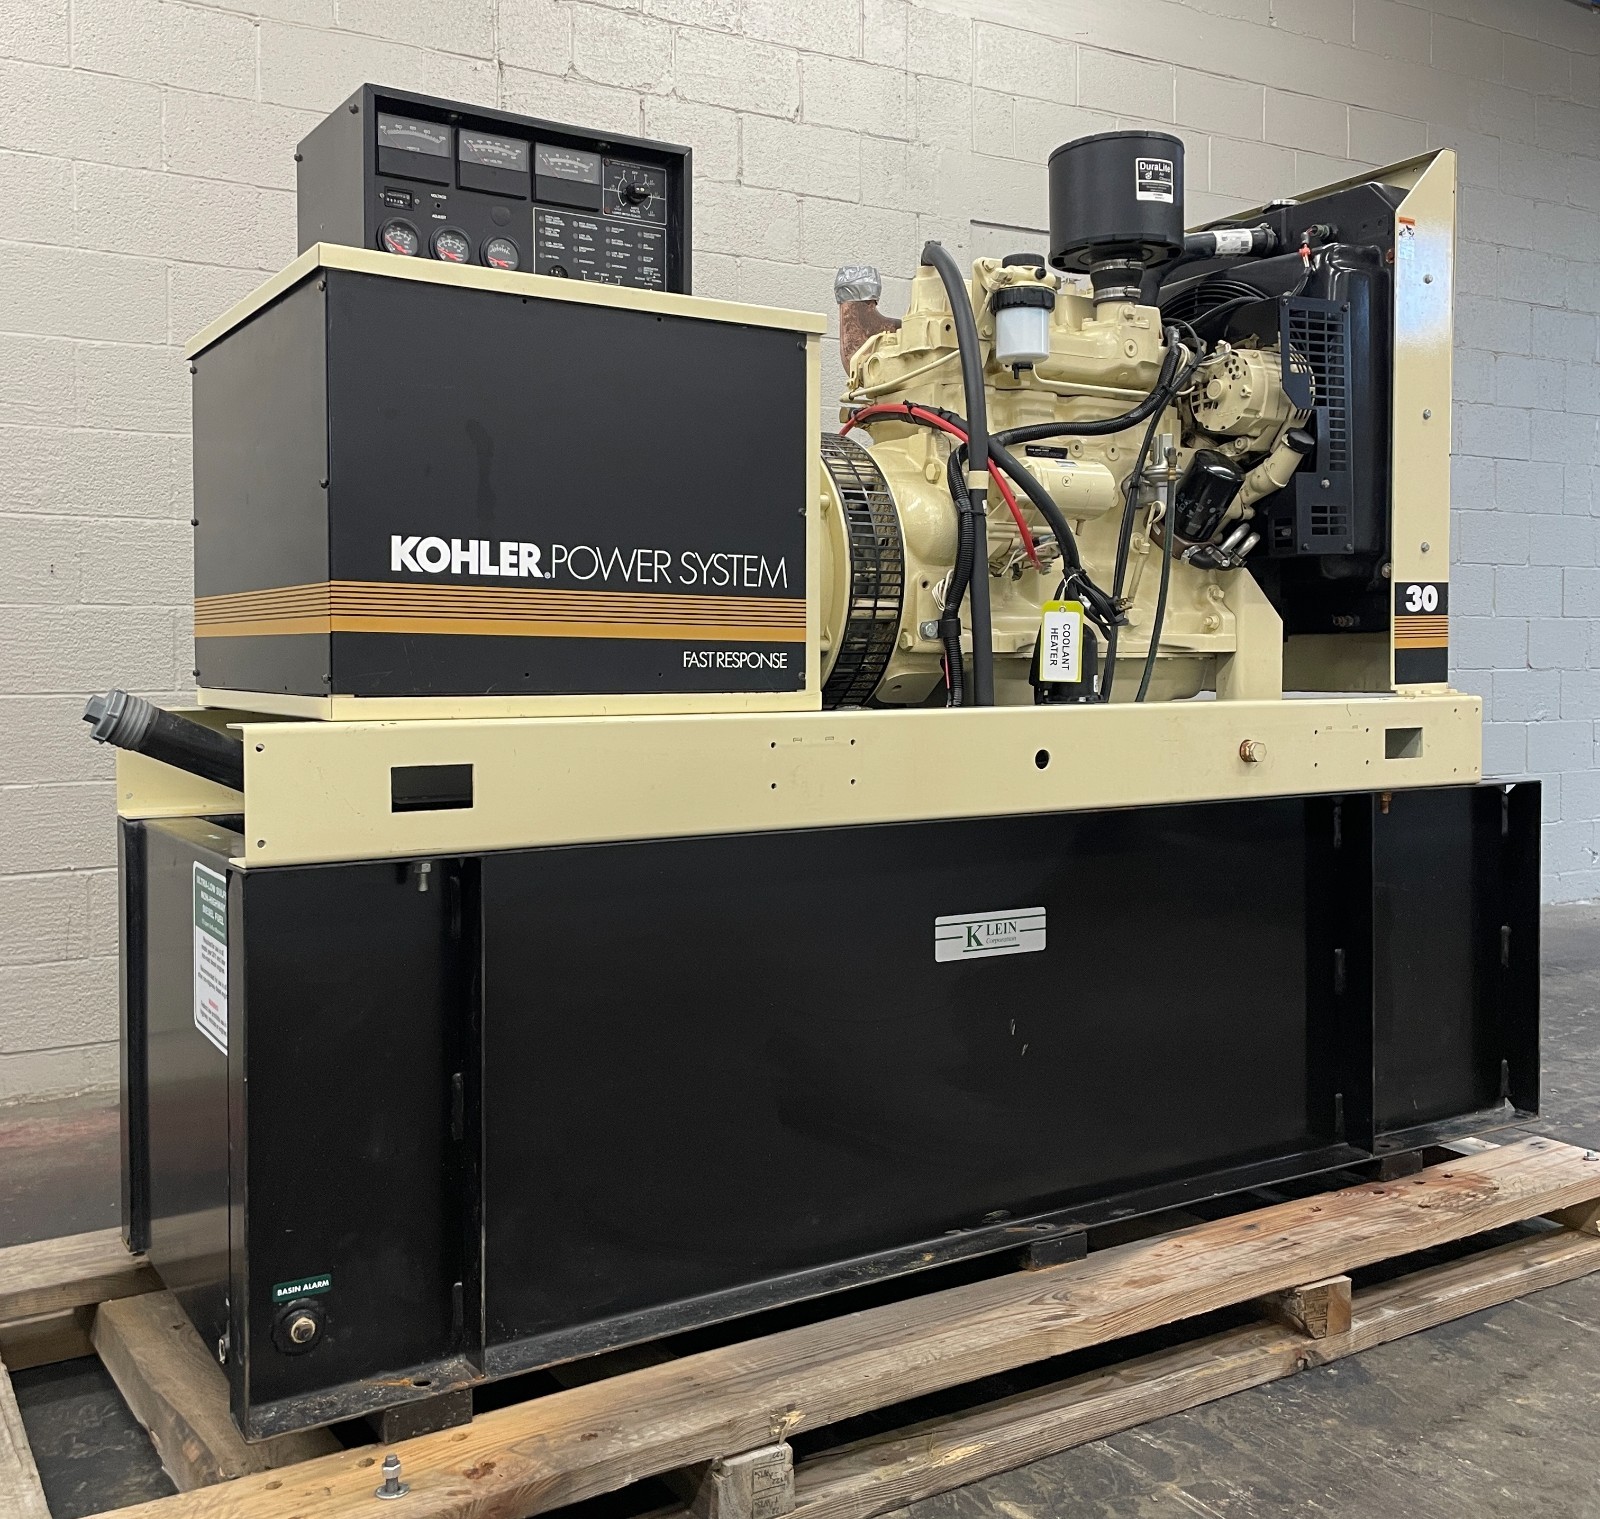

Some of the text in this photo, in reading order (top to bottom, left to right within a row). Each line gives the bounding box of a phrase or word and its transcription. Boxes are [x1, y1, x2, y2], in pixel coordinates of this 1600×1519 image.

[1140, 161, 1171, 173] DuraLite
[551, 543, 672, 584] POWER
[679, 550, 789, 589] SYSTEM
[1405, 584, 1439, 612] 30
[682, 650, 788, 669] FAST RESPONSE
[1049, 627, 1059, 666] HEATER
[1061, 623, 1071, 671] COOLANT
[966, 921, 1017, 948] KLEIN
[985, 935, 1017, 945] Corporation
[277, 1279, 329, 1296] BASIN ALARM
